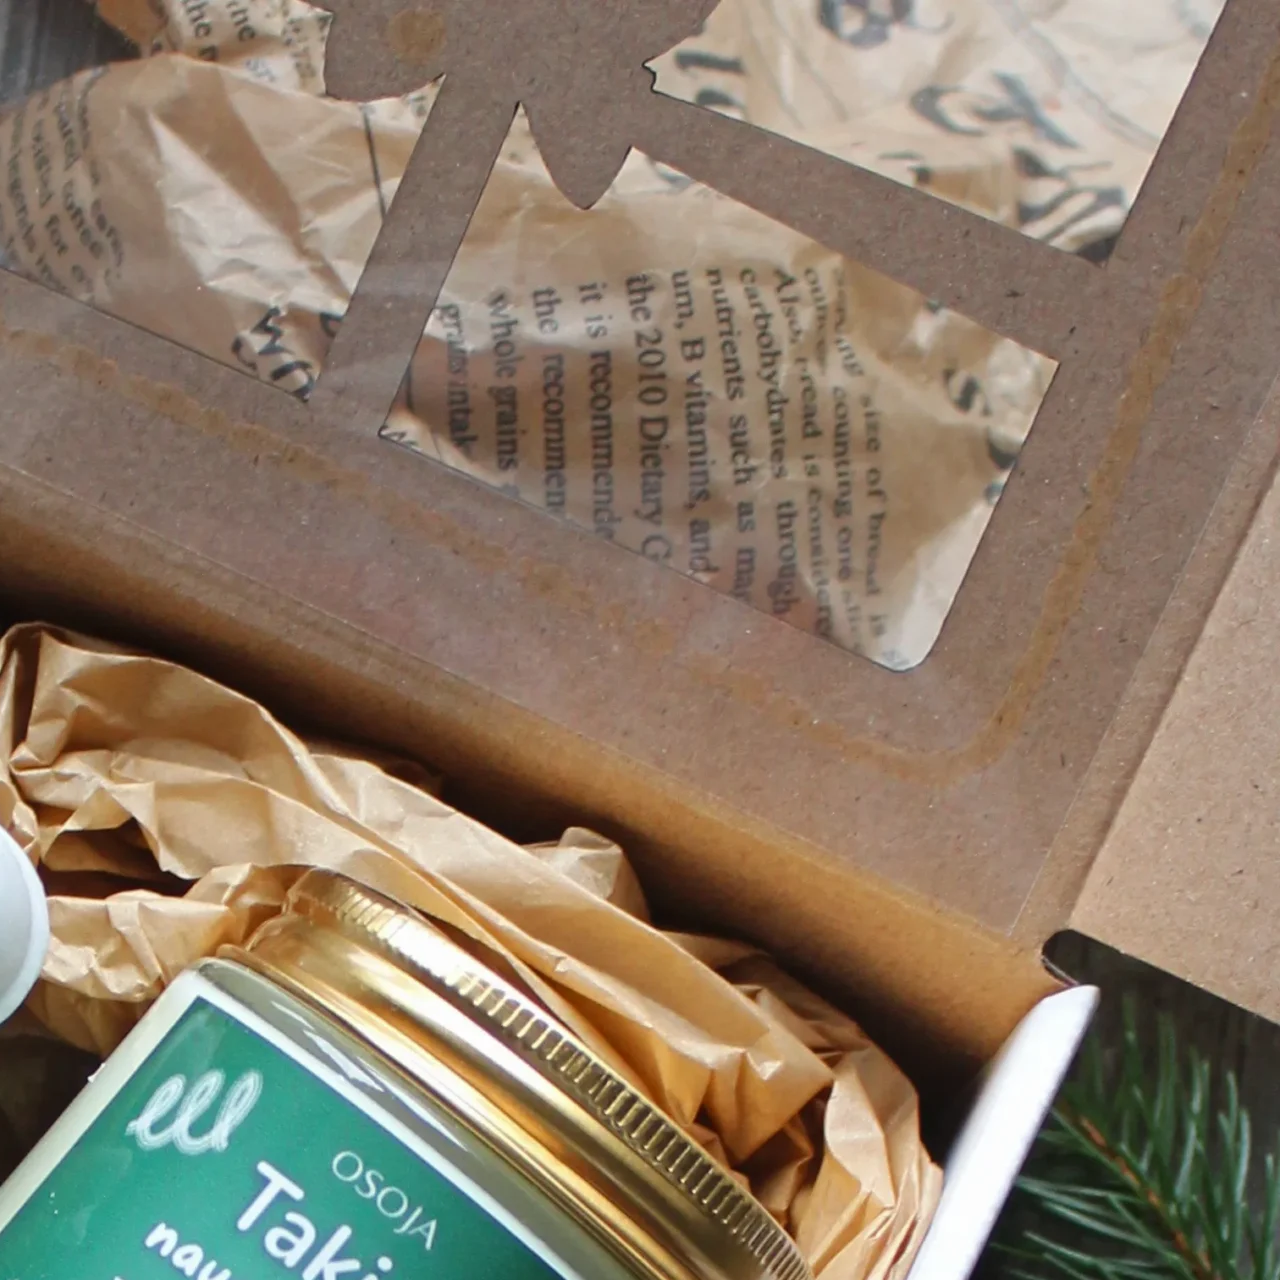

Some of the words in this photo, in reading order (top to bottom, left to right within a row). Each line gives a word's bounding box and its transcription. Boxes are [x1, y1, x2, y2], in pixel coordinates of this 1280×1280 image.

[532, 286, 562, 335] the
[580, 282, 607, 310] it
[583, 313, 613, 340] is
[625, 274, 655, 323] the
[489, 290, 523, 379] whole
[635, 328, 668, 407] 2010
[681, 336, 705, 361] B
[706, 268, 744, 401] nutrients
[488, 384, 526, 472] grains
[684, 370, 715, 510] vitamins,
[730, 415, 757, 486] such
[743, 269, 790, 479] carbohydrates
[767, 501, 801, 615] through
[831, 388, 853, 518] counting
[634, 416, 670, 526] Dietary
[802, 453, 821, 477] is
[866, 467, 887, 500] of
[689, 521, 721, 574] and
[738, 501, 756, 532] as
[332, 1150, 437, 1249] OSOJA
